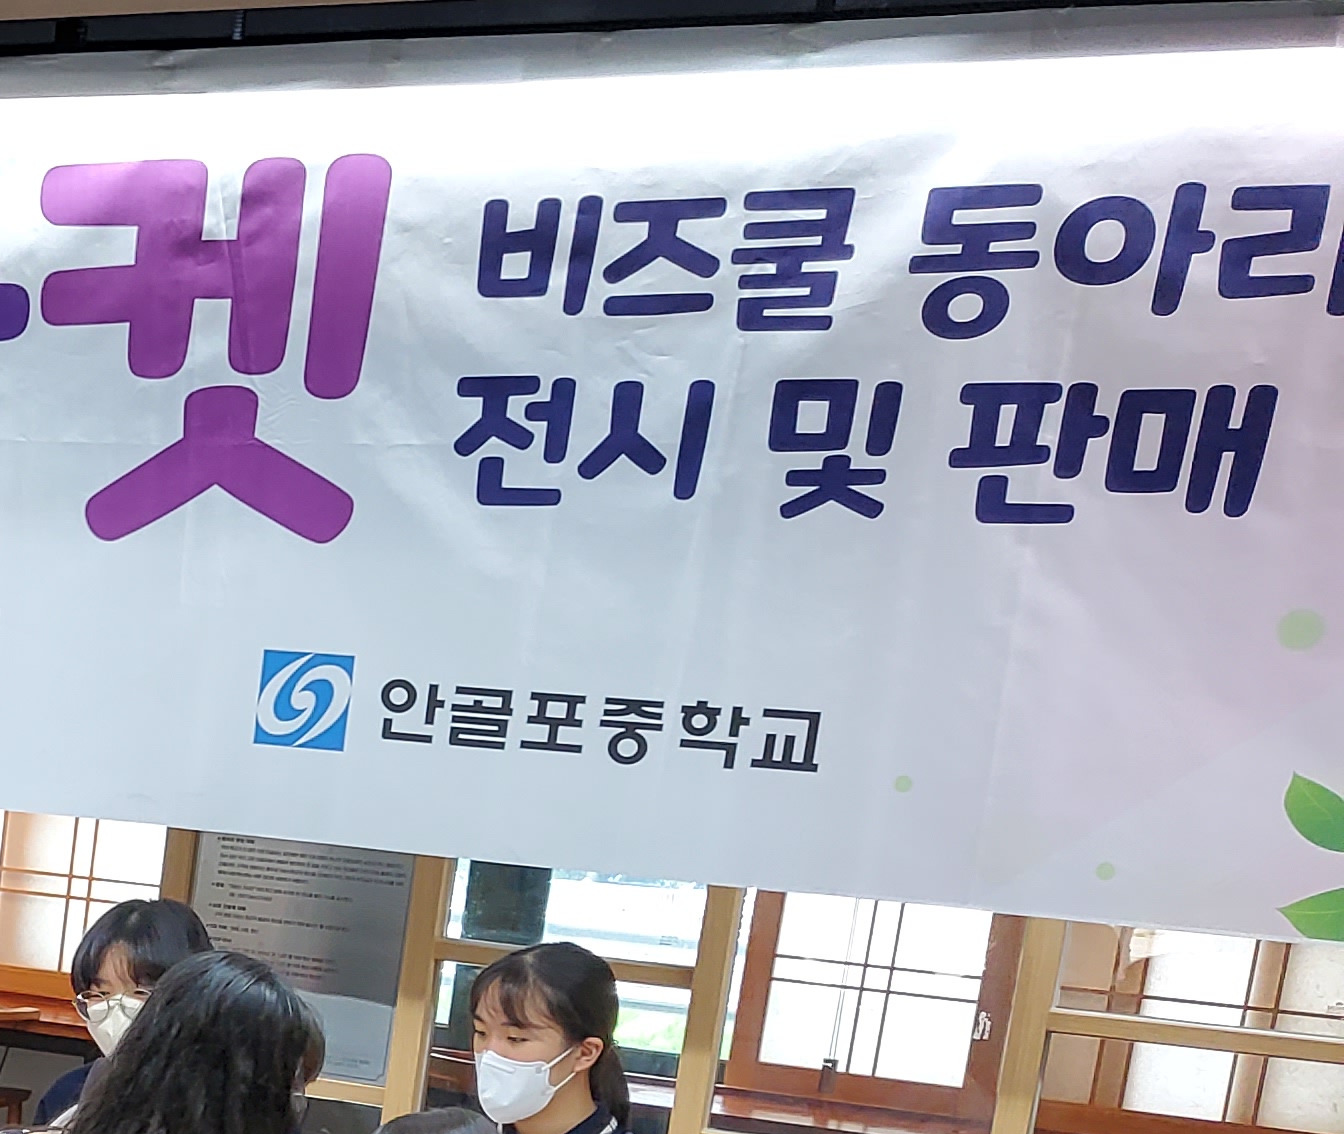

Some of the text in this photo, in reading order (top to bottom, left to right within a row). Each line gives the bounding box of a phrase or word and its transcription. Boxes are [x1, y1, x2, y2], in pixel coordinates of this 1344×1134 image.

[477, 181, 1344, 340] 비즈쿨 동아리
[453, 375, 1280, 526] 전시 및 판매
[379, 676, 824, 775] 안골포중학교
